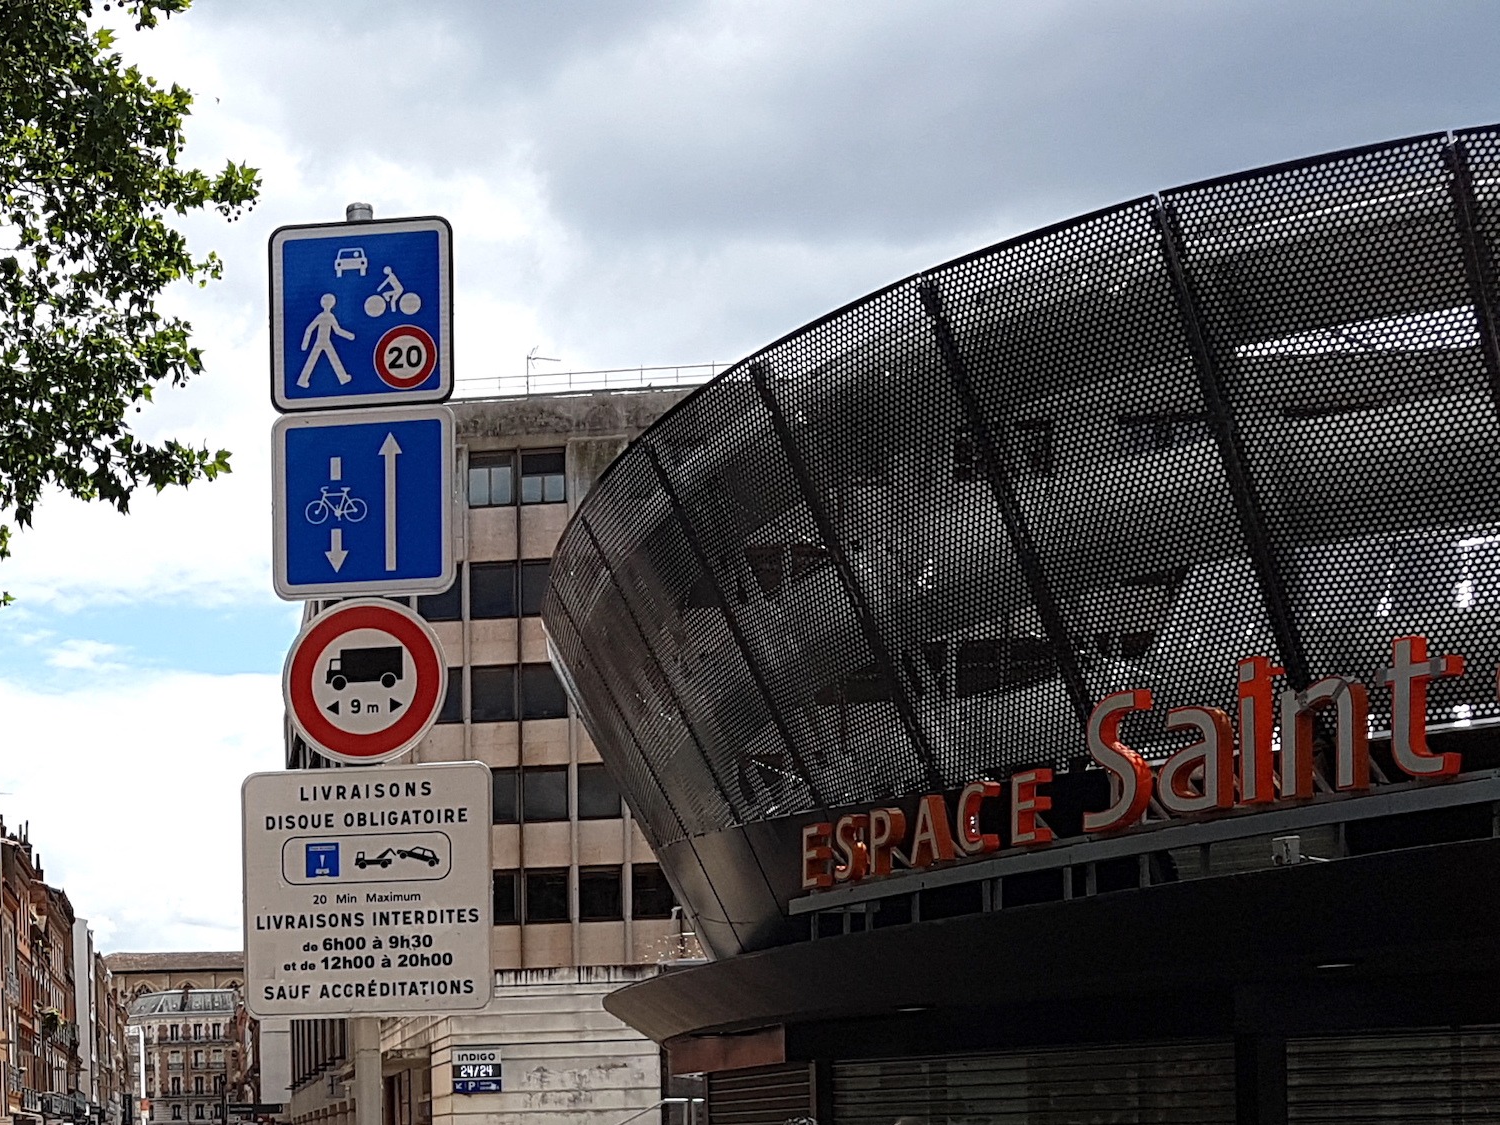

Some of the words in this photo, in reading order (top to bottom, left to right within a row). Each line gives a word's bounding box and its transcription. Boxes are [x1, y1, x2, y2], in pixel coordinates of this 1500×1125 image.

[388, 345, 422, 368] 20
[351, 699, 361, 714] 9
[367, 704, 379, 713] m
[802, 767, 1053, 889] ESPACE
[1082, 635, 1464, 834] Saint
[299, 781, 432, 801] LIVRAISONS
[265, 813, 335, 830] DISQUE
[343, 807, 468, 827] OBLIGATOIRE
[313, 894, 327, 905] 20
[336, 893, 357, 904] Min
[365, 891, 421, 903] Maximum
[256, 913, 365, 930] LIVRAISONS
[372, 909, 479, 927] INTERDITES
[302, 941, 318, 952] de
[322, 936, 367, 951] 6h00
[372, 935, 383, 950] à
[389, 934, 433, 949] 9h30
[283, 960, 297, 971] et
[300, 960, 316, 971] de
[320, 955, 375, 970] 12h00
[381, 954, 392, 969] à
[398, 953, 453, 969] 20h00
[264, 985, 311, 1000] SAUF
[320, 979, 474, 999] ACCRÉDITATIONS
[457, 1053, 495, 1061] INDIGO
[460, 1065, 493, 1077] 24/24
[468, 1081, 476, 1091] P
